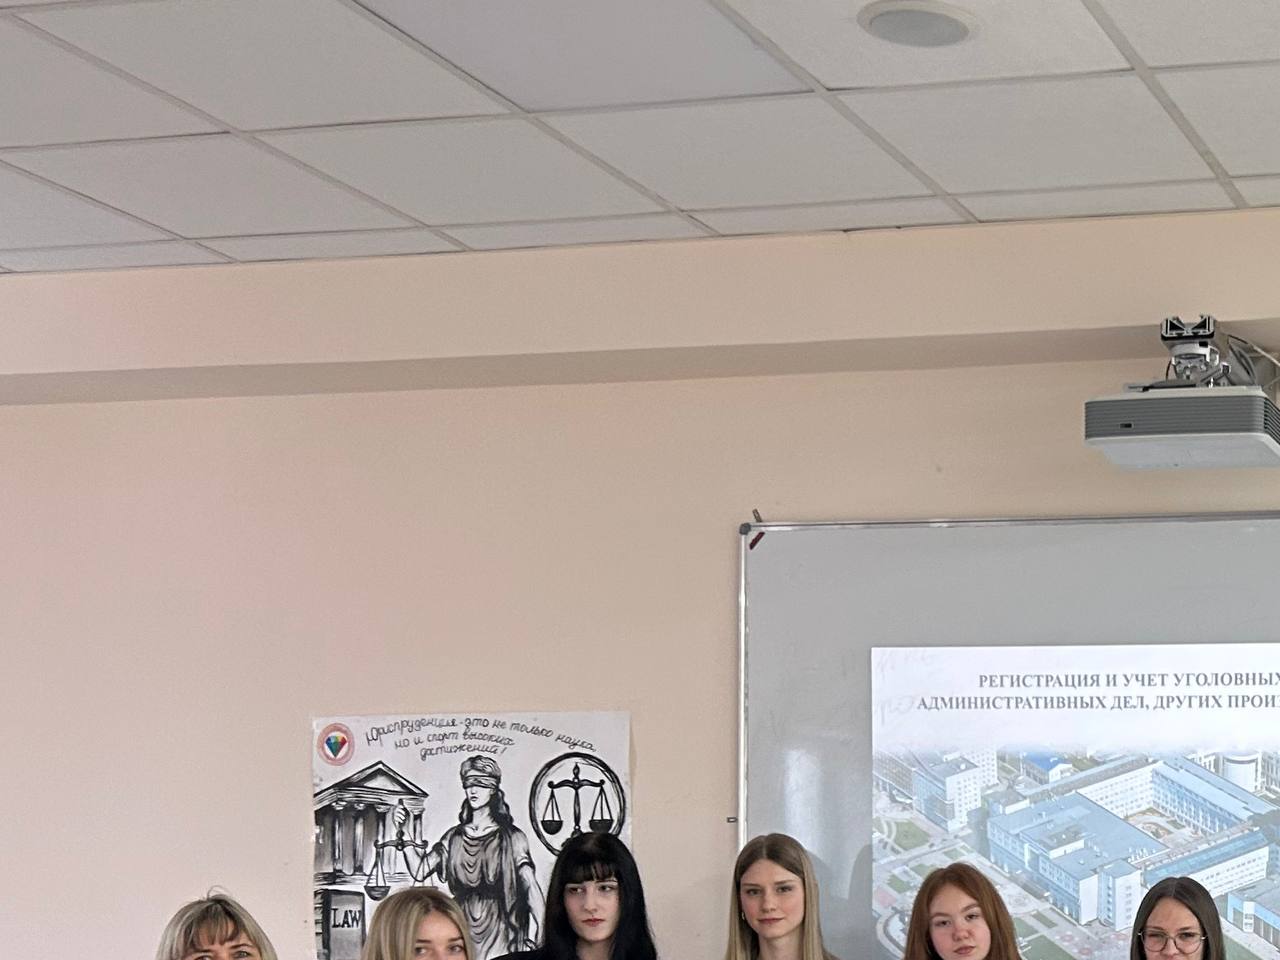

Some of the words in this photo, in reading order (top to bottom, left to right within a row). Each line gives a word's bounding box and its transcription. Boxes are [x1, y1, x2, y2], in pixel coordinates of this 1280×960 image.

[979, 673, 1101, 689] РЕГИСТРАЦИЯ
[1105, 673, 1117, 687] И
[1122, 672, 1169, 687] УЧЕТ
[916, 695, 1107, 711] АДМИНИСТРАТИВНЫХ
[1110, 695, 1150, 711] ДЕЛ,
[1152, 694, 1223, 711] ДРУГИХ
[492, 719, 507, 729] не
[509, 721, 554, 738] только
[394, 737, 410, 750] но
[414, 736, 423, 746] и
[427, 731, 459, 745] спорт
[462, 727, 516, 746] высоких
[331, 907, 362, 929] LAW
